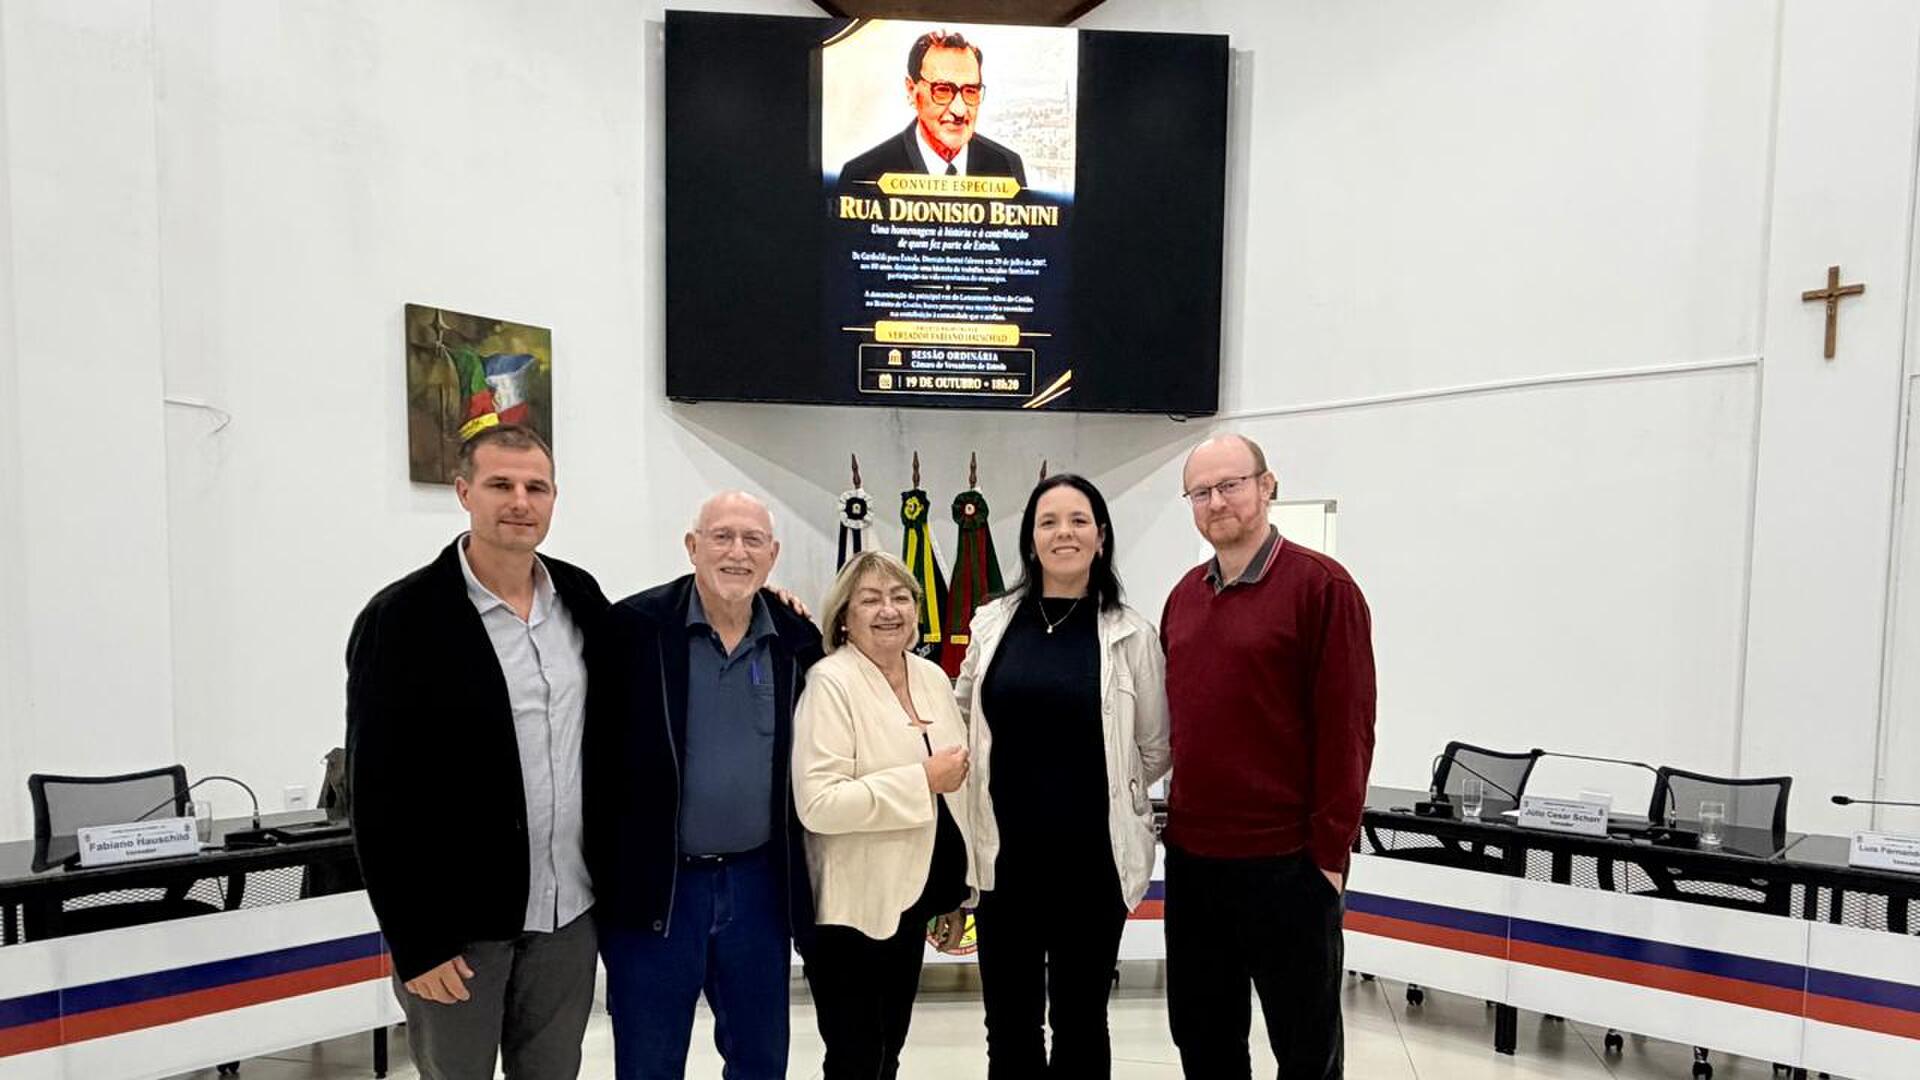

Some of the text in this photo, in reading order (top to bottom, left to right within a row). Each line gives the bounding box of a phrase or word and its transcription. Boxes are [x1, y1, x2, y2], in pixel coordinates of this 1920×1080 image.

[890, 178, 1009, 193] CONVITE ESPECIAL
[840, 195, 1059, 226] RUA DIONISIO BENINI
[871, 224, 889, 235] Uma
[891, 225, 936, 238] homenagem
[944, 227, 971, 238] história
[985, 229, 1030, 240] contribuição
[897, 237, 907, 248] de
[908, 241, 928, 250] quem
[929, 238, 941, 251] fez
[942, 240, 962, 251] parte
[963, 239, 972, 250] de
[911, 349, 998, 362] SESSÃO ORDINÁRIA
[906, 376, 917, 388] 19
[919, 376, 934, 388] DE
[935, 377, 982, 389] OUTUBRO
[88, 840, 134, 852] Fabiano
[136, 833, 190, 846] Hauschild
